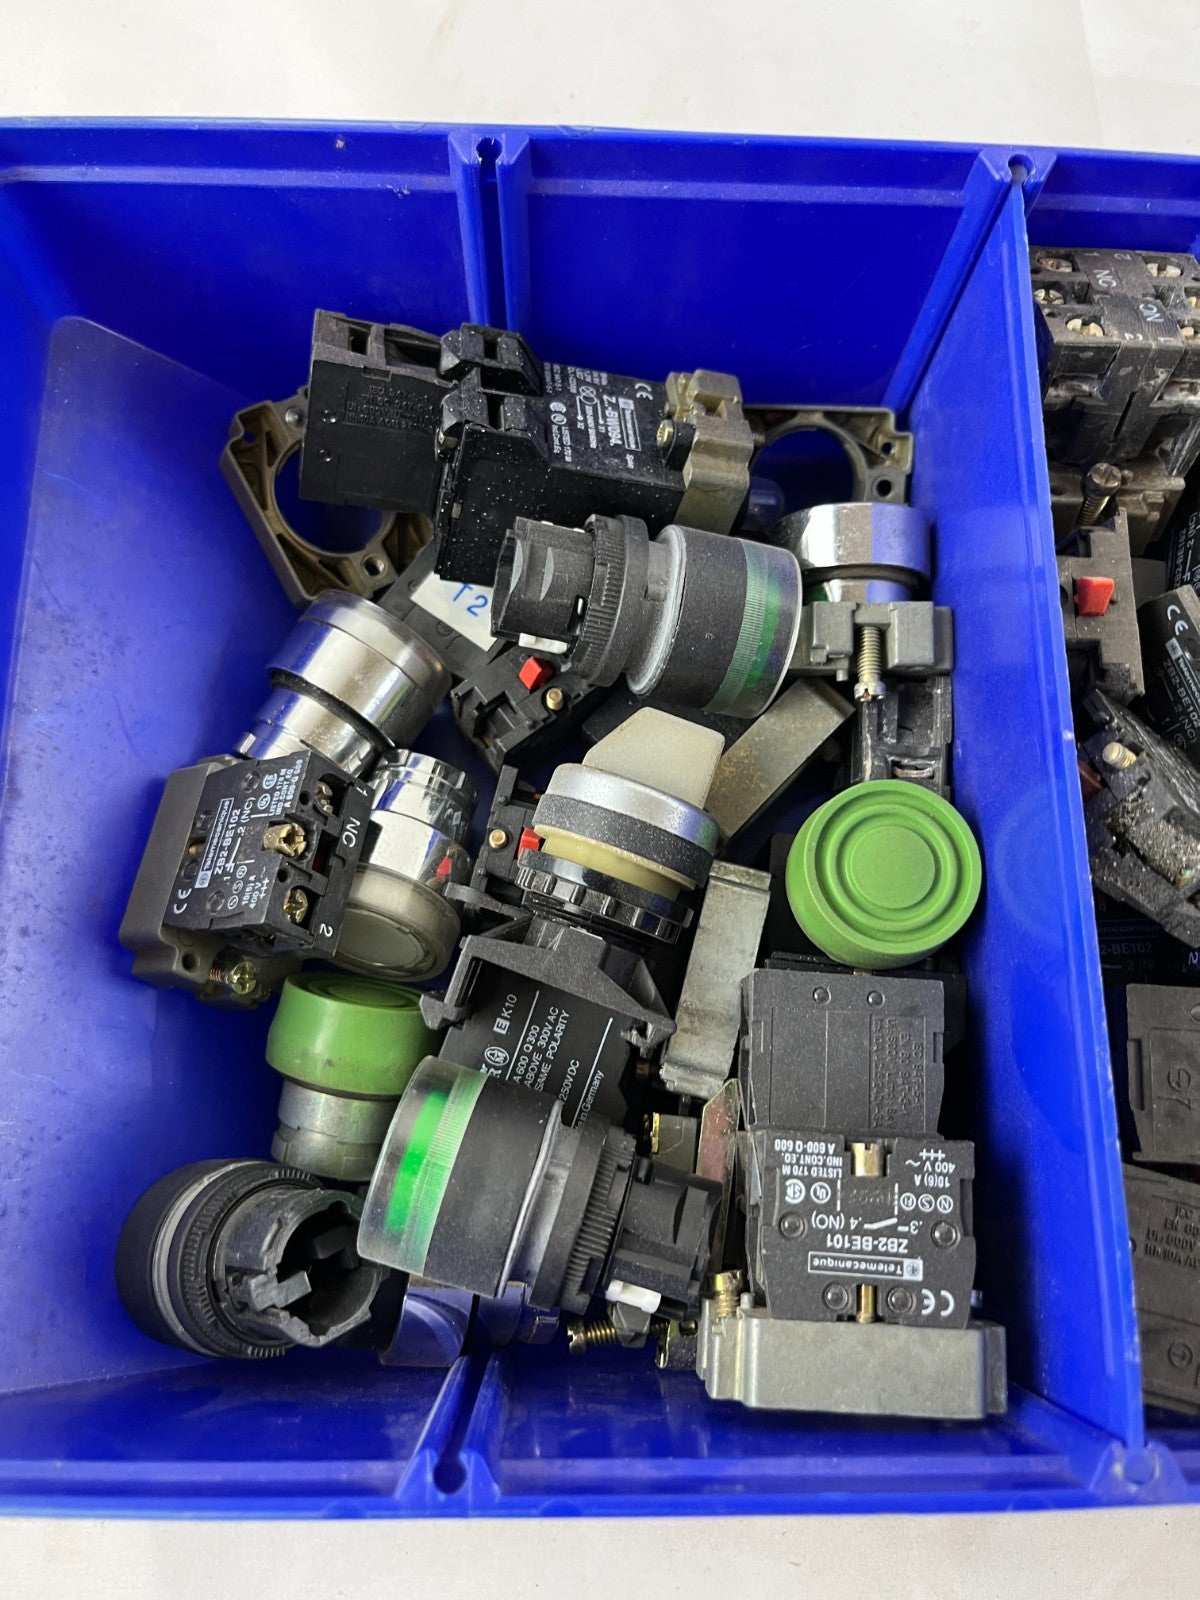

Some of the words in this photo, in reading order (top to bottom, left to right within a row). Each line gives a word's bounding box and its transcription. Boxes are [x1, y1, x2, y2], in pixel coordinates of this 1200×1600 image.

[1093, 270, 1117, 287] NC
[1139, 303, 1164, 323] NC
[635, 382, 653, 401] CE
[452, 584, 488, 617] T2
[1167, 604, 1189, 636] CE
[356, 786, 368, 798] 1
[240, 797, 256, 823] (NC)
[269, 791, 280, 816] LISTED
[203, 801, 230, 871] Telemecanique
[342, 817, 361, 848] NC
[214, 809, 241, 876] ZB2-BE102
[173, 888, 192, 915] CE
[249, 891, 260, 909] 400
[319, 923, 333, 938] 2
[526, 1025, 540, 1045] 300
[523, 1043, 533, 1053] Q
[524, 1052, 543, 1088] ABOVE
[537, 1022, 553, 1049] 300V
[547, 1006, 559, 1023] AC
[535, 1062, 552, 1092] SAME
[546, 1009, 570, 1060] POLARITY
[516, 1055, 529, 1075] 600
[567, 1059, 580, 1076] DC
[513, 1075, 522, 1083] A
[581, 1069, 605, 1112] Germany
[774, 1139, 794, 1152] 600
[827, 1143, 836, 1155] A
[781, 1164, 791, 1175] M
[792, 1165, 809, 1176] 170
[811, 1166, 843, 1178] LISTED
[923, 1161, 932, 1172] V
[934, 1161, 956, 1174] 400
[914, 1174, 922, 1187] A
[924, 1173, 951, 1188] 10(6)
[811, 1210, 845, 1230] (NO)
[826, 1233, 909, 1253] ZB2-BE101
[812, 1257, 903, 1275] Telemecanique
[921, 1288, 955, 1317] CE
